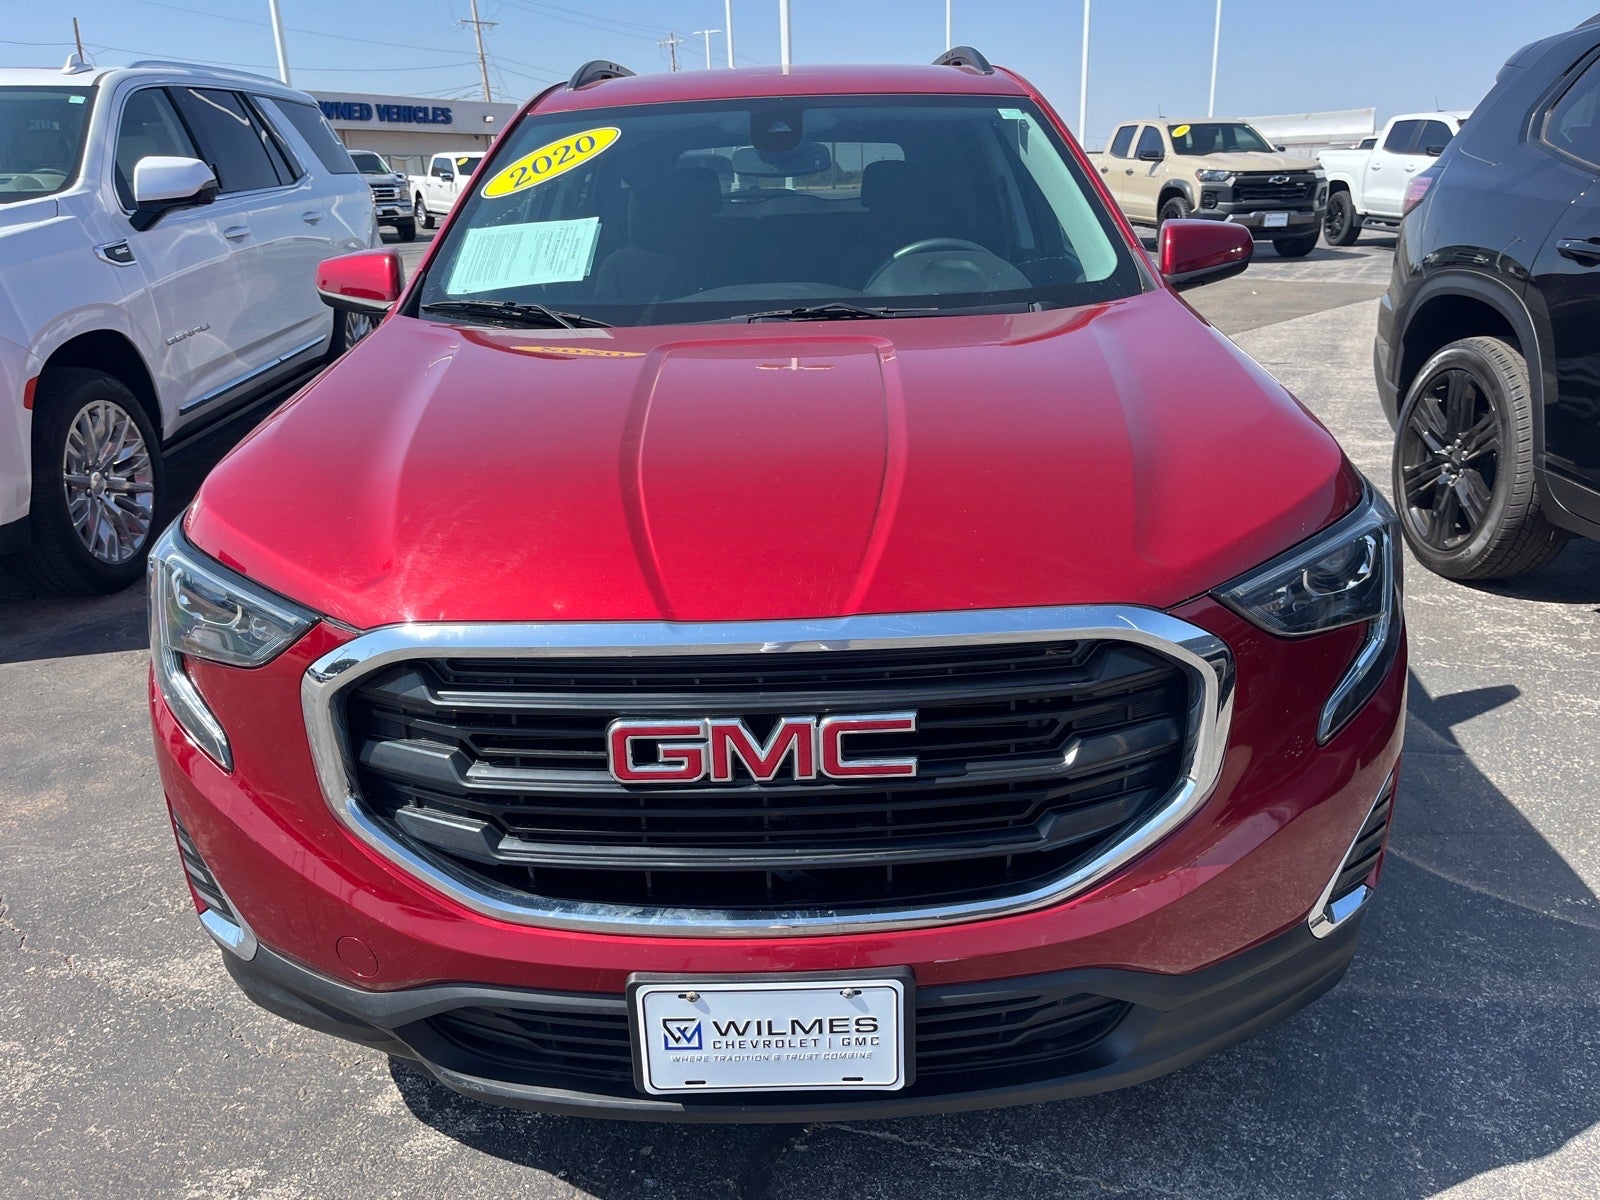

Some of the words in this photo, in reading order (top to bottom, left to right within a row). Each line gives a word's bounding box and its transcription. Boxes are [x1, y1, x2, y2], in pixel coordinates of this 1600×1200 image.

[317, 100, 373, 121] WNED
[375, 104, 453, 125] VEHICLES
[509, 135, 596, 188] 2020
[605, 711, 918, 784] GMC
[711, 1016, 879, 1037] WILMES
[712, 1038, 820, 1050] CHEVROLET
[841, 1036, 880, 1047] GMC
[672, 1055, 710, 1063] WHERE
[713, 1055, 770, 1063] TRADITION
[785, 1053, 820, 1061] TRUST
[823, 1051, 873, 1060] COMBINE
